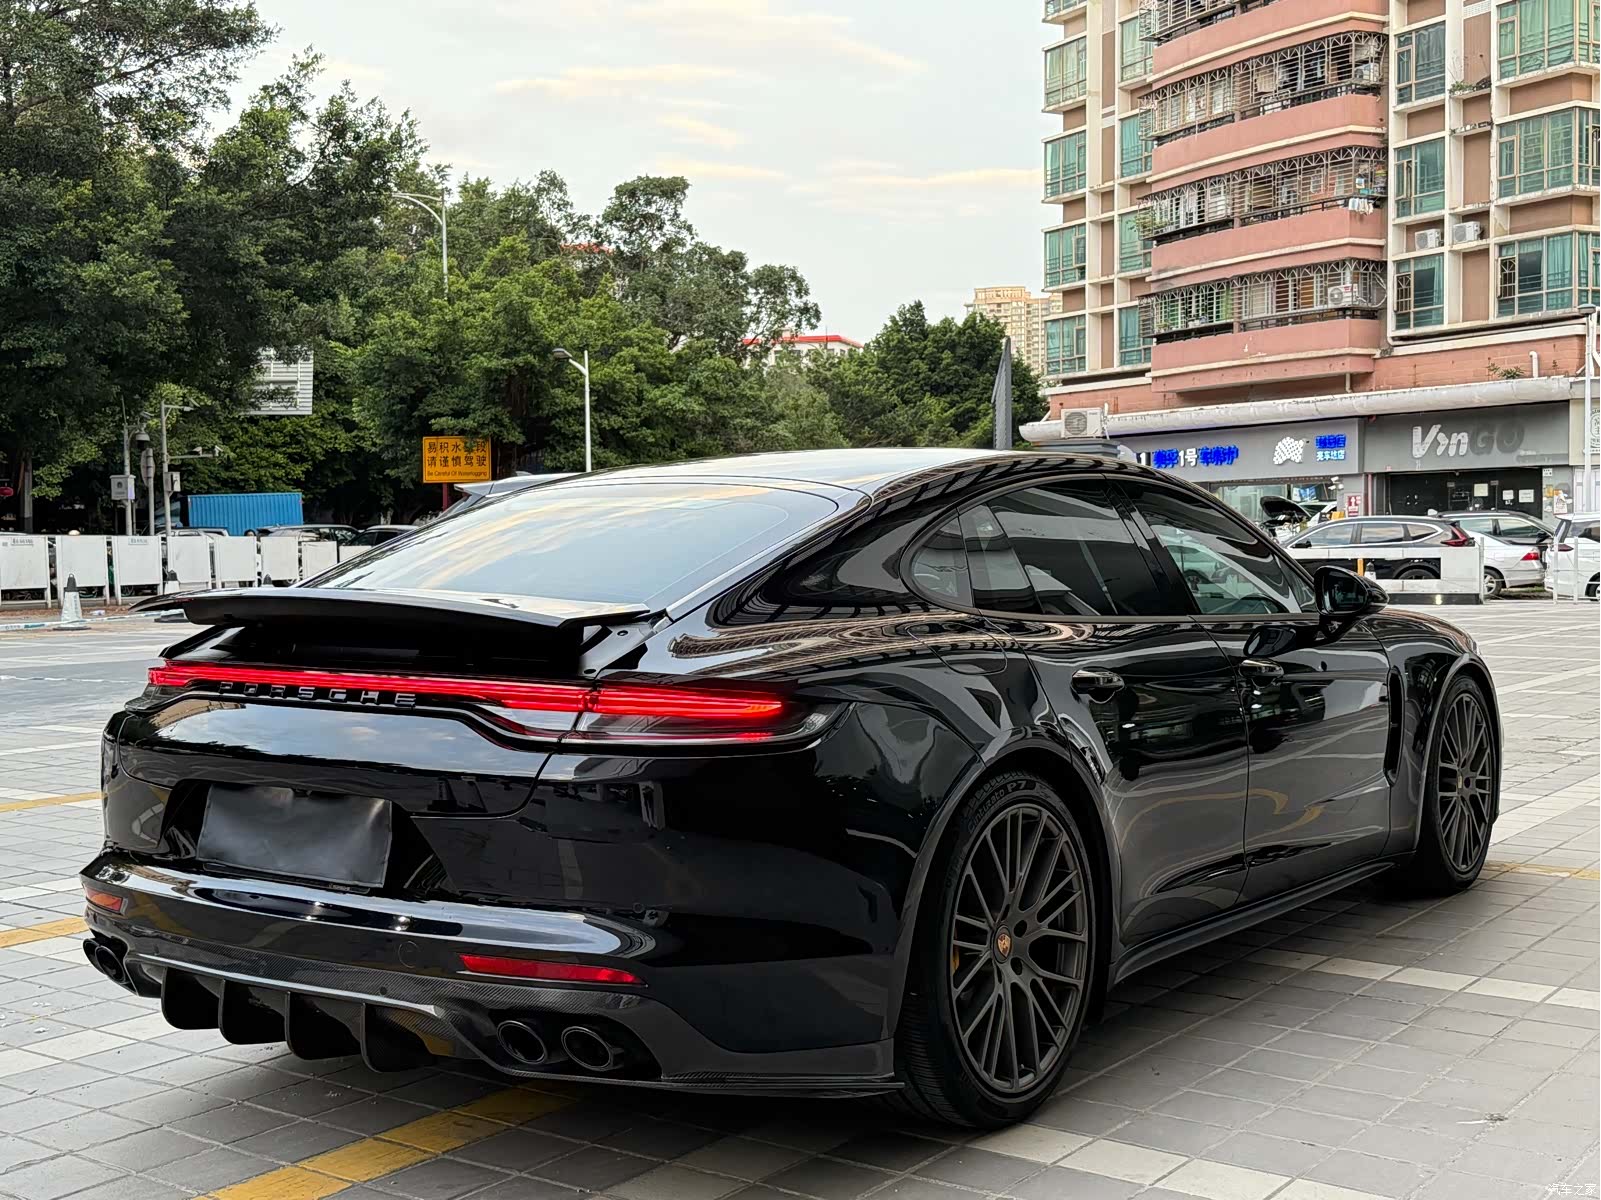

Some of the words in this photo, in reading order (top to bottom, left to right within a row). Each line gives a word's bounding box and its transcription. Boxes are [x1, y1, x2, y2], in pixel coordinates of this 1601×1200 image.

[427, 441, 486, 453] 易积水段
[427, 456, 487, 467] 请谨慎驾驶
[219, 681, 416, 709] PORSCHE
[1006, 780, 1028, 793] P7
